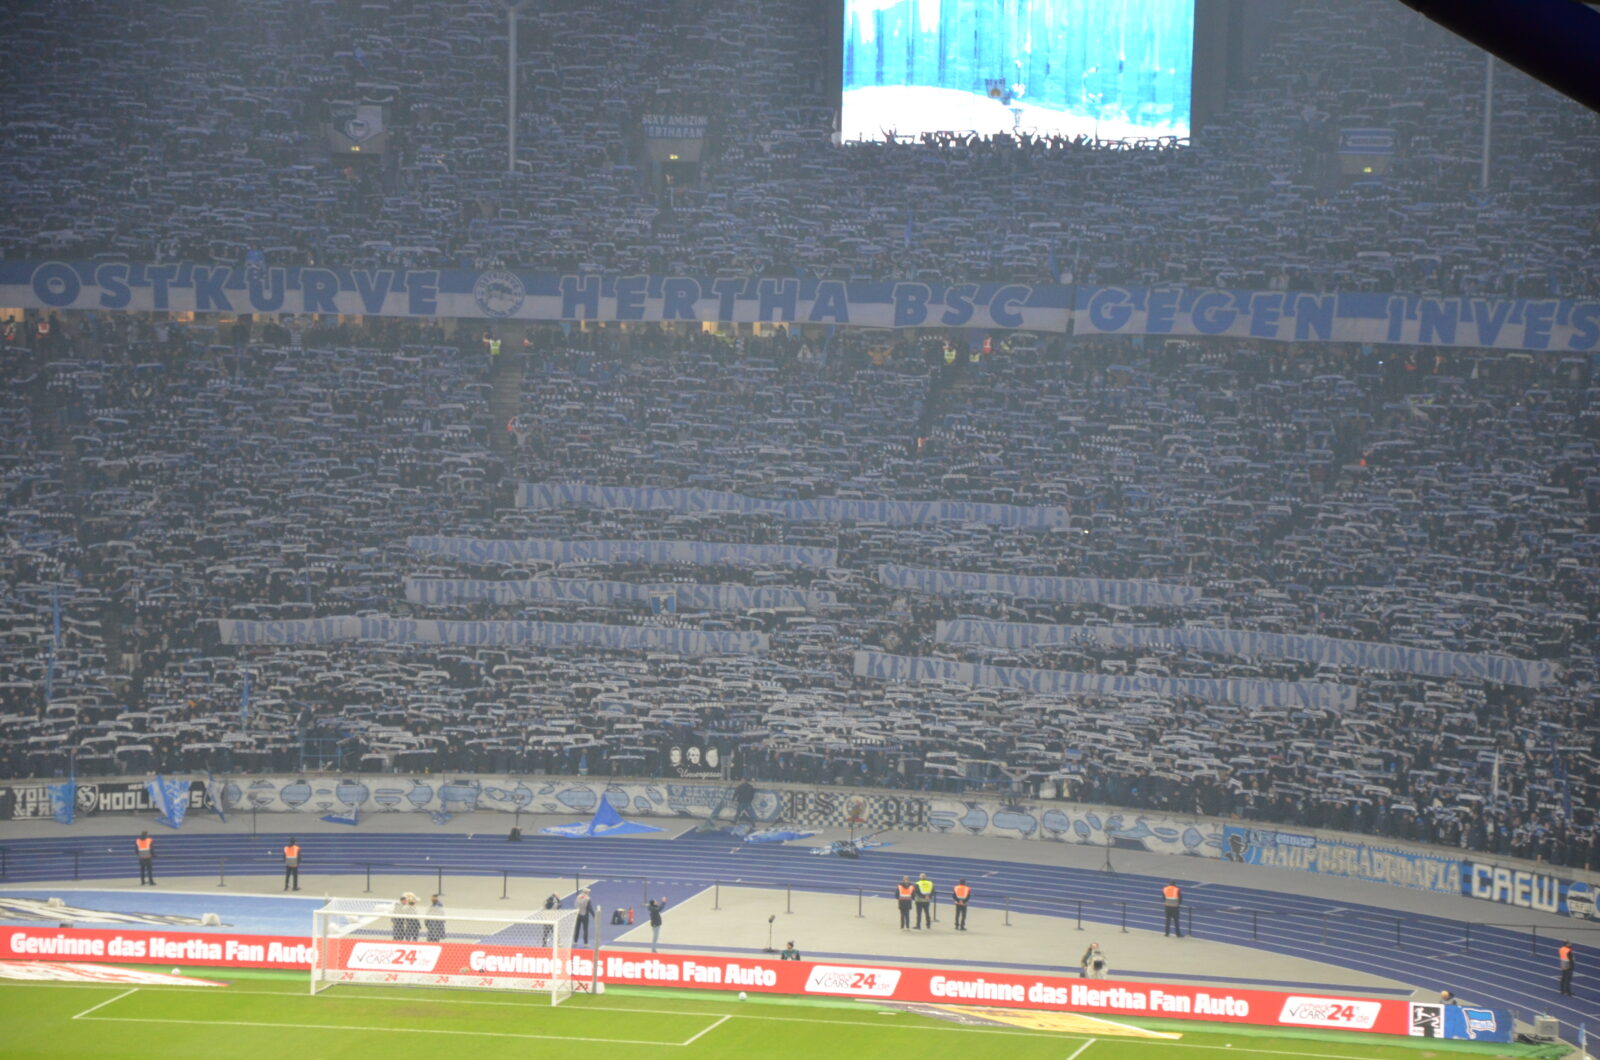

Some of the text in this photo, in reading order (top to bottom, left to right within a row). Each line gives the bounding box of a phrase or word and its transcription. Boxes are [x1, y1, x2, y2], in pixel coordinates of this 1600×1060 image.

[30, 260, 1034, 329] OSTKURVE HERTHA BSC
[1088, 286, 1600, 350] GEGEN INVES
[229, 618, 343, 644] AUSBAU
[360, 617, 418, 643] DER
[866, 652, 960, 683] KEINE
[1472, 863, 1559, 913] CREW
[10, 932, 319, 964] Gewinne das Hertha Fan Auto
[470, 950, 777, 987] Gewinne das Hertha Fan Auto
[929, 975, 1249, 1018] Gewinne das Hertha Fan Auto
